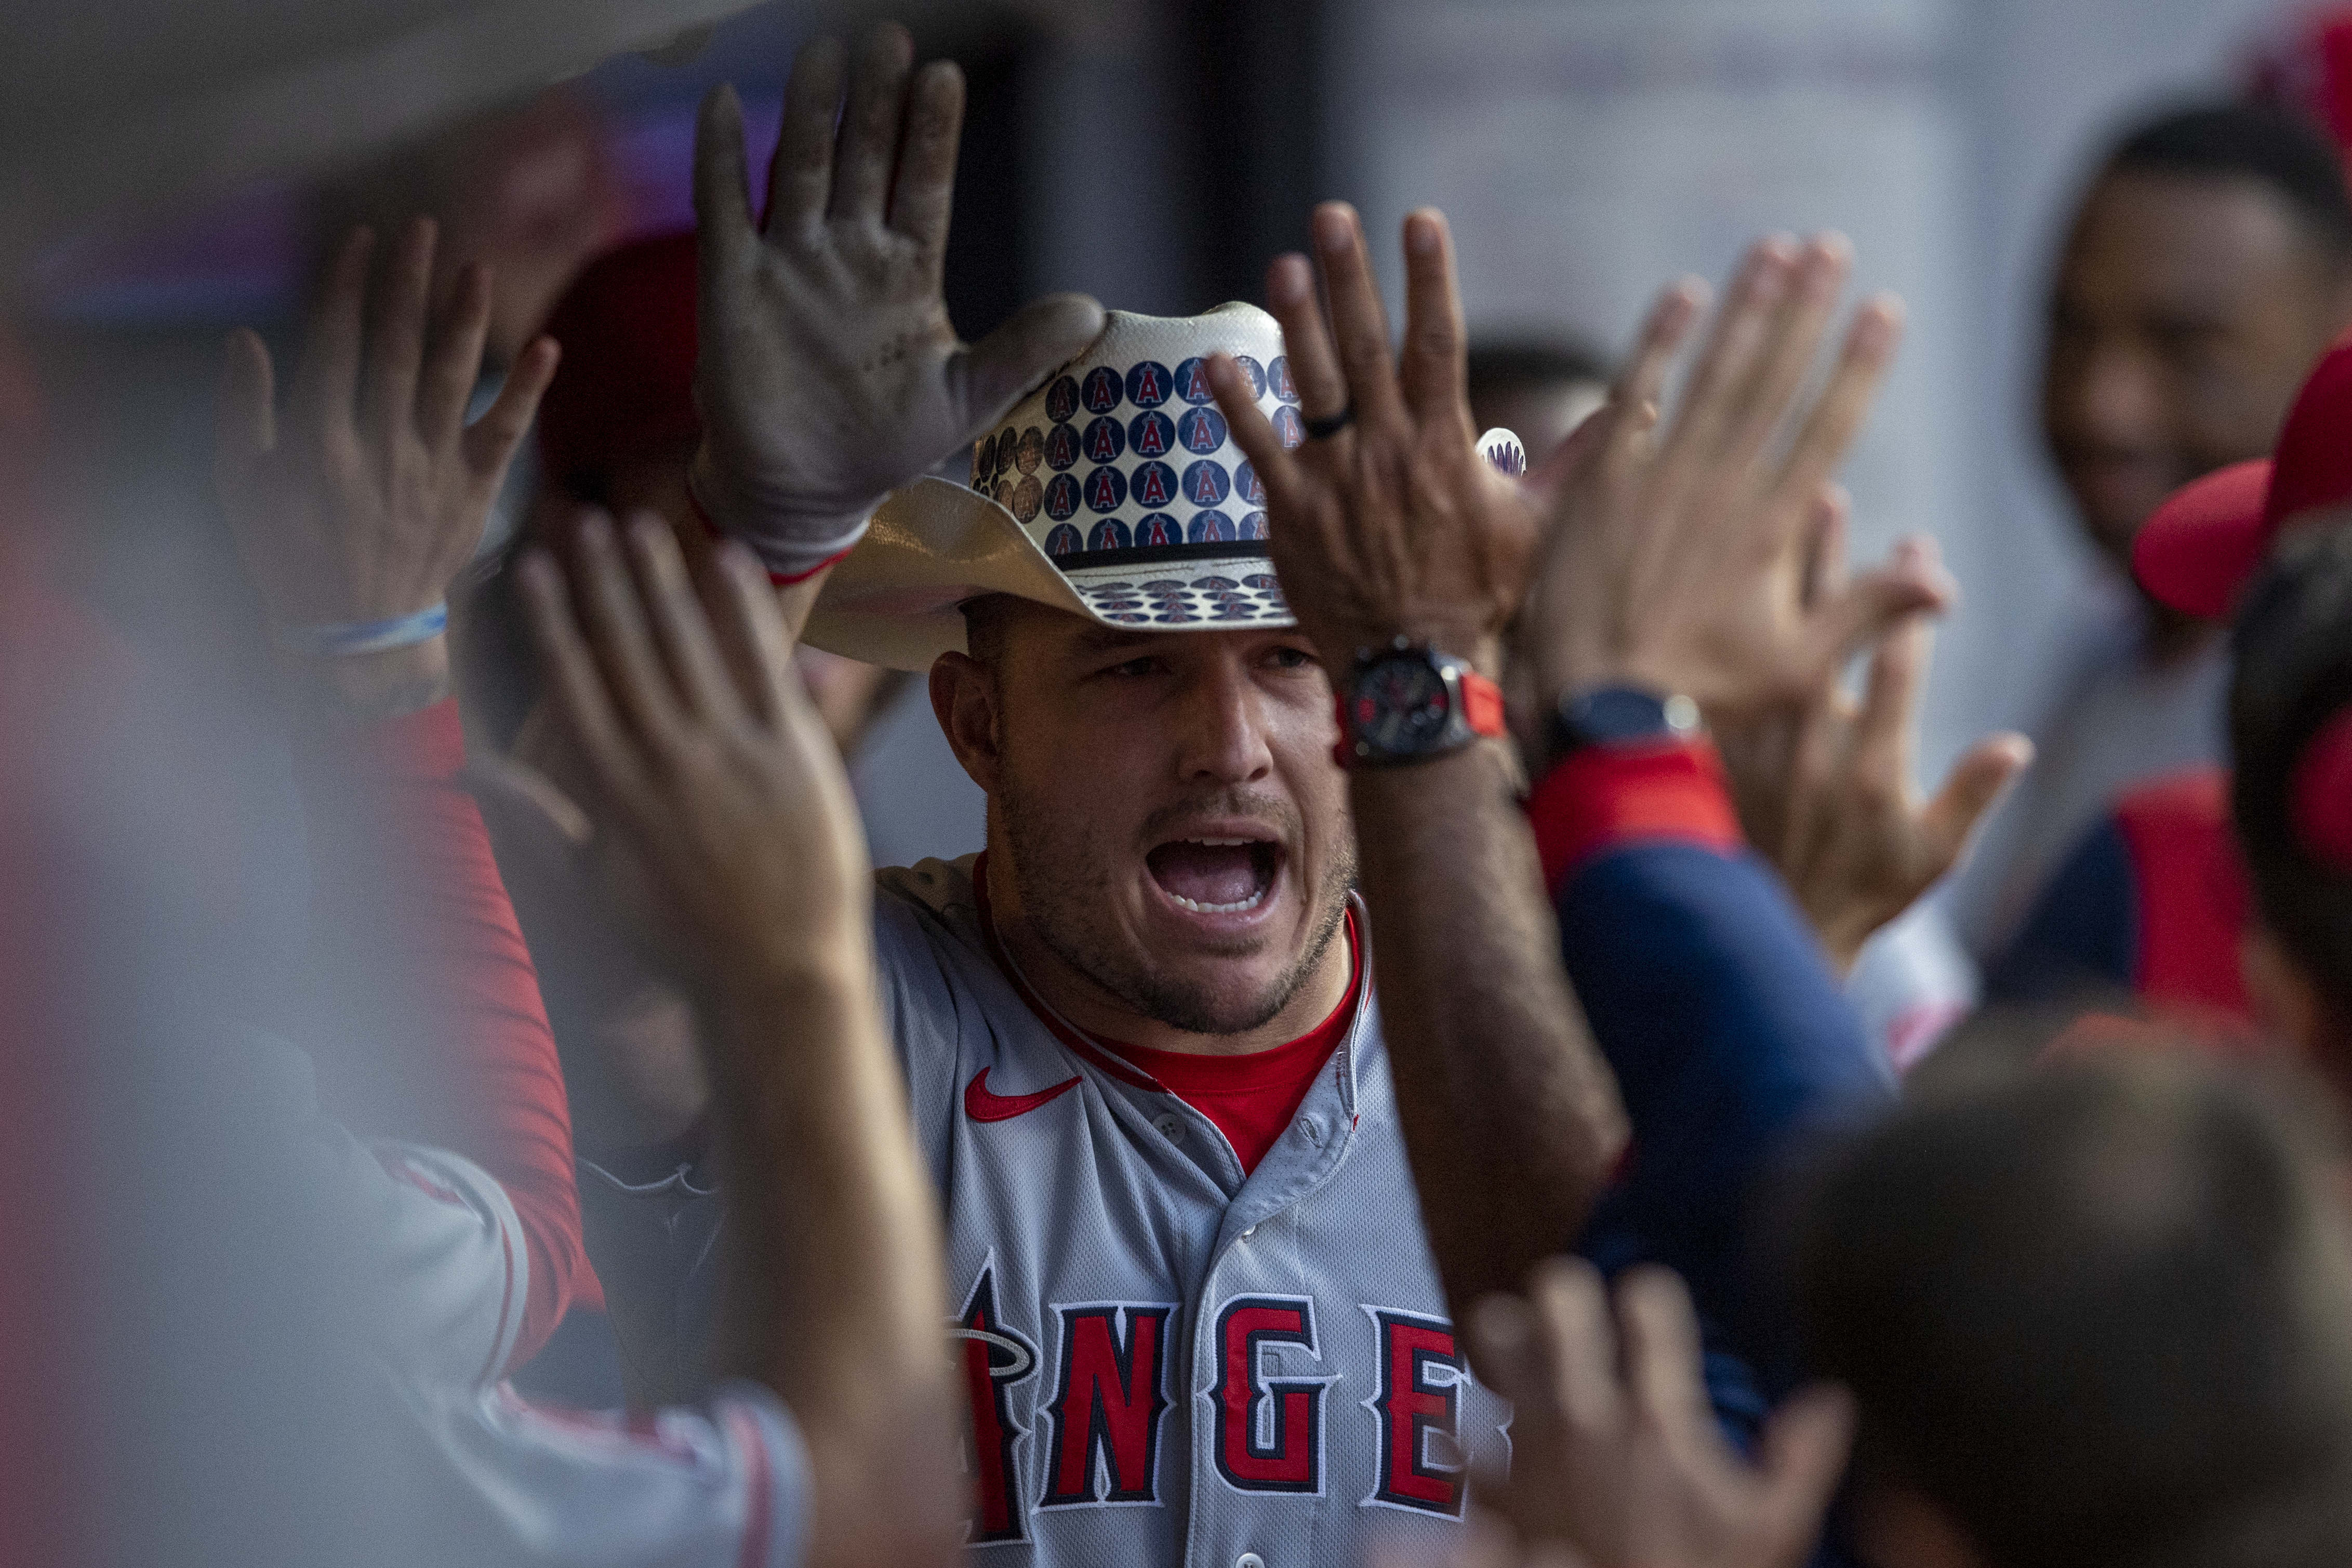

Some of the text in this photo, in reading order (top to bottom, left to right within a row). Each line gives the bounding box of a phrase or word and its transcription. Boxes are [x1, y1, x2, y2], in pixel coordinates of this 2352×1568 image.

[1091, 367, 1115, 410] A
[1135, 363, 1163, 403] A
[1186, 358, 1214, 400] A
[1279, 356, 1299, 398] A
[1052, 424, 1073, 467] A
[1092, 417, 1116, 459] A
[1137, 411, 1166, 453] A
[1190, 408, 1218, 449] A
[1284, 407, 1303, 449] A
[1051, 474, 1071, 515] A
[1093, 467, 1117, 509] A
[1141, 462, 1168, 503] A
[1194, 461, 1221, 502] A
[1055, 525, 1073, 554] A
[1100, 520, 1118, 550] A
[1148, 514, 1169, 546] A
[1202, 510, 1222, 542] A
[941, 1246, 1514, 1548] ANGE
